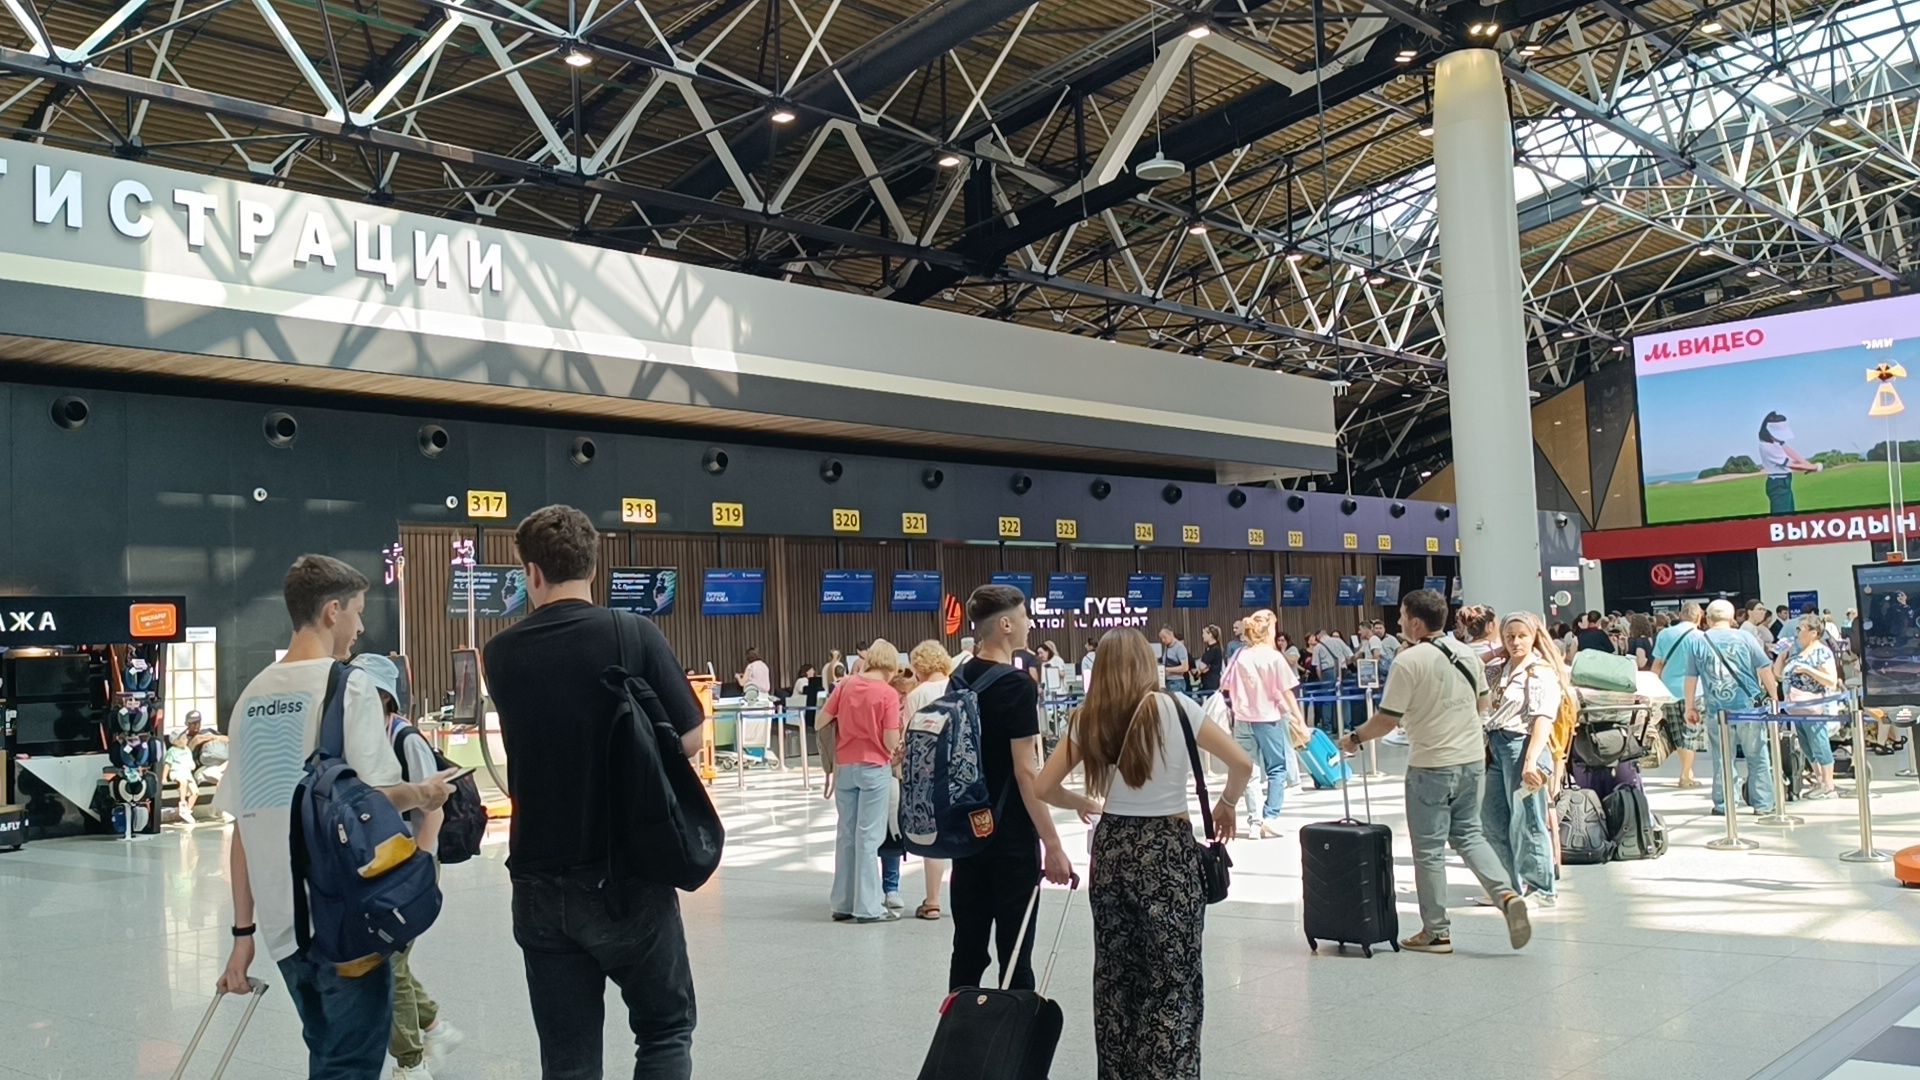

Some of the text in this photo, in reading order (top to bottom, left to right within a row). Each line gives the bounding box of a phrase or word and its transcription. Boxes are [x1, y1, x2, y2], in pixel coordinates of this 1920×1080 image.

[471, 495, 503, 512] 317
[625, 502, 654, 519] 318
[715, 506, 741, 522] 319
[835, 512, 857, 527] 320
[905, 515, 925, 531] 321
[1001, 519, 1019, 533] 322
[1058, 522, 1075, 535] 323
[1769, 511, 1920, 542] ВЫХОДЫ Н
[1136, 525, 1152, 538] 324
[1184, 528, 1199, 540] 325
[1250, 531, 1262, 543] 326
[1289, 533, 1301, 544] 327
[1092, 616, 1149, 628] AIRPORT
[247, 700, 304, 718] endless
